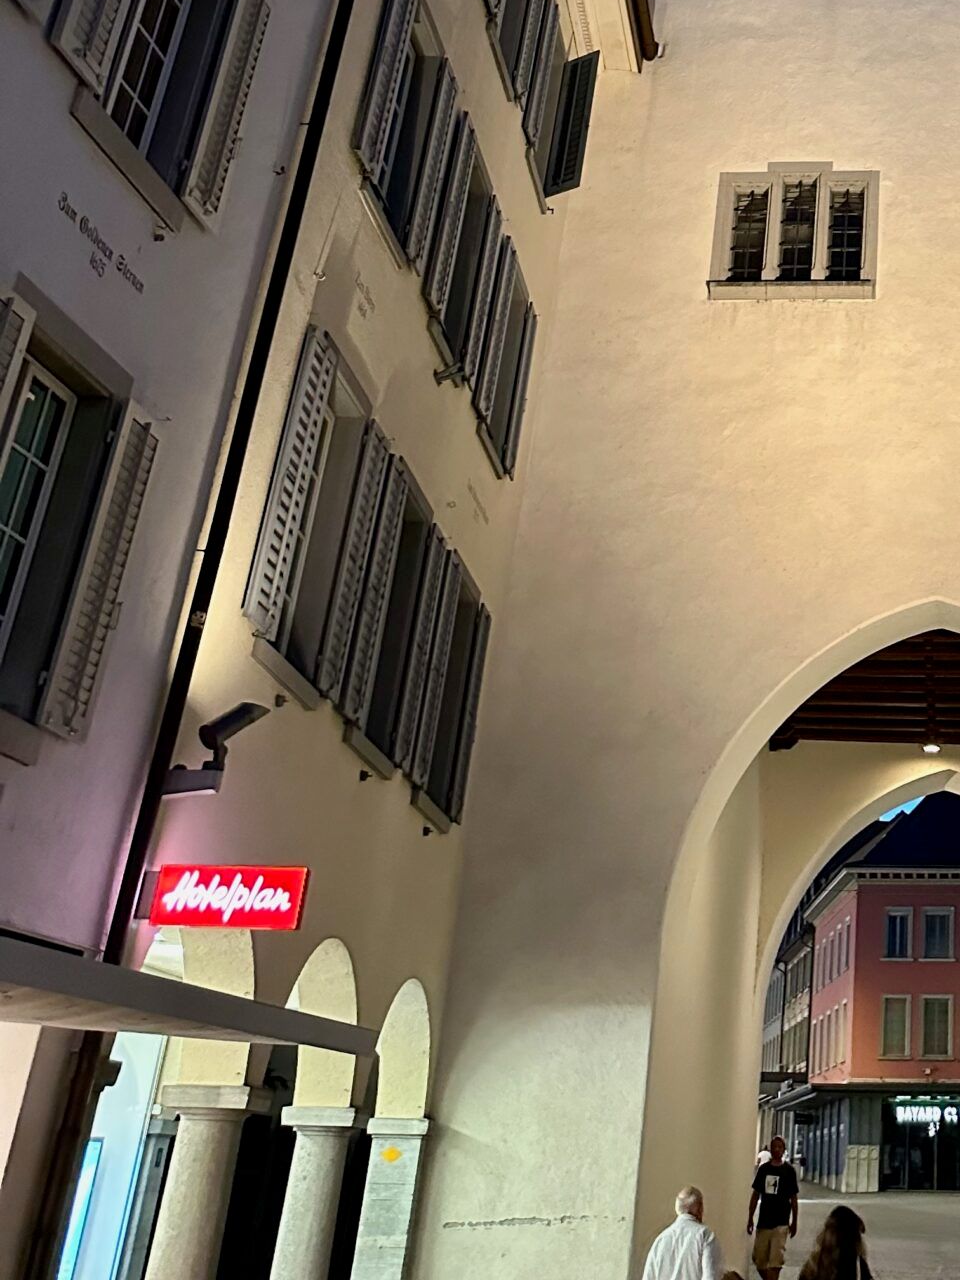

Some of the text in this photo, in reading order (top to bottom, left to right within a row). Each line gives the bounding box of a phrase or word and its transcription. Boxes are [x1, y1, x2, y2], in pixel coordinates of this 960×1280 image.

[57, 191, 77, 224] Zum
[162, 869, 292, 924] Hotelplan
[895, 1106, 941, 1122] BAYARD
